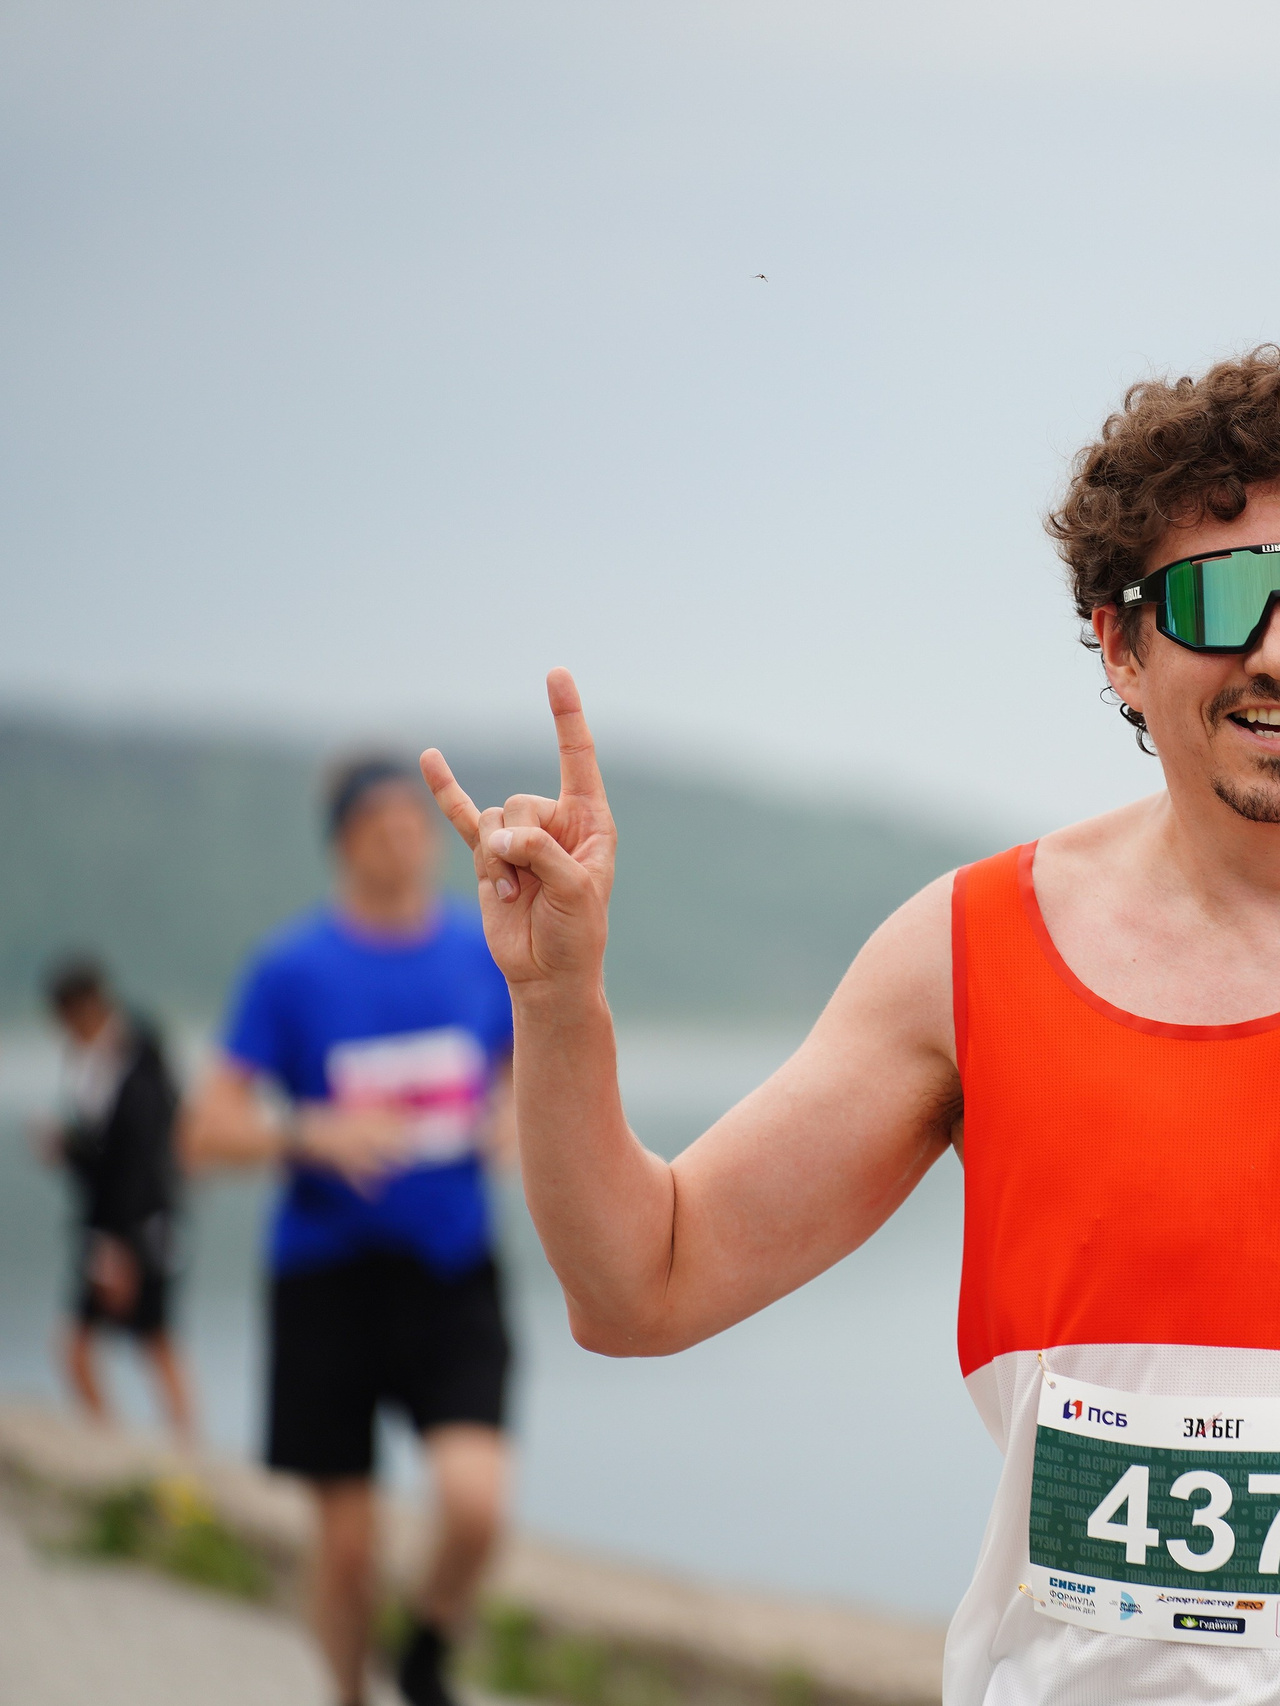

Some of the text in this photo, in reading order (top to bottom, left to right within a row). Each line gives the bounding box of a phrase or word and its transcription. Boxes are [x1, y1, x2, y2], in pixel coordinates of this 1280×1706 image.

[1087, 1406, 1128, 1428] ПСБ
[1078, 1453, 1091, 1469] НА
[1053, 1465, 1070, 1481] БЕГ
[1070, 1468, 1078, 1483] В
[1078, 1471, 1103, 1488] СЕБЕ
[1046, 1482, 1078, 1501] ДАВНО
[1158, 1519, 1172, 1535] НА
[1079, 1543, 1117, 1562] СТРЕСС
[1049, 1577, 1096, 1595] СИБУР
[1124, 1568, 1164, 1586] ТОЛЬКО
[1165, 1572, 1206, 1590] НАЧАЛО
[1223, 1576, 1236, 1592] НА
[1237, 1577, 1275, 1593] СТАРТЕ
[1049, 1589, 1096, 1608] ФОРМУЛА
[1236, 1601, 1264, 1610] PRO
